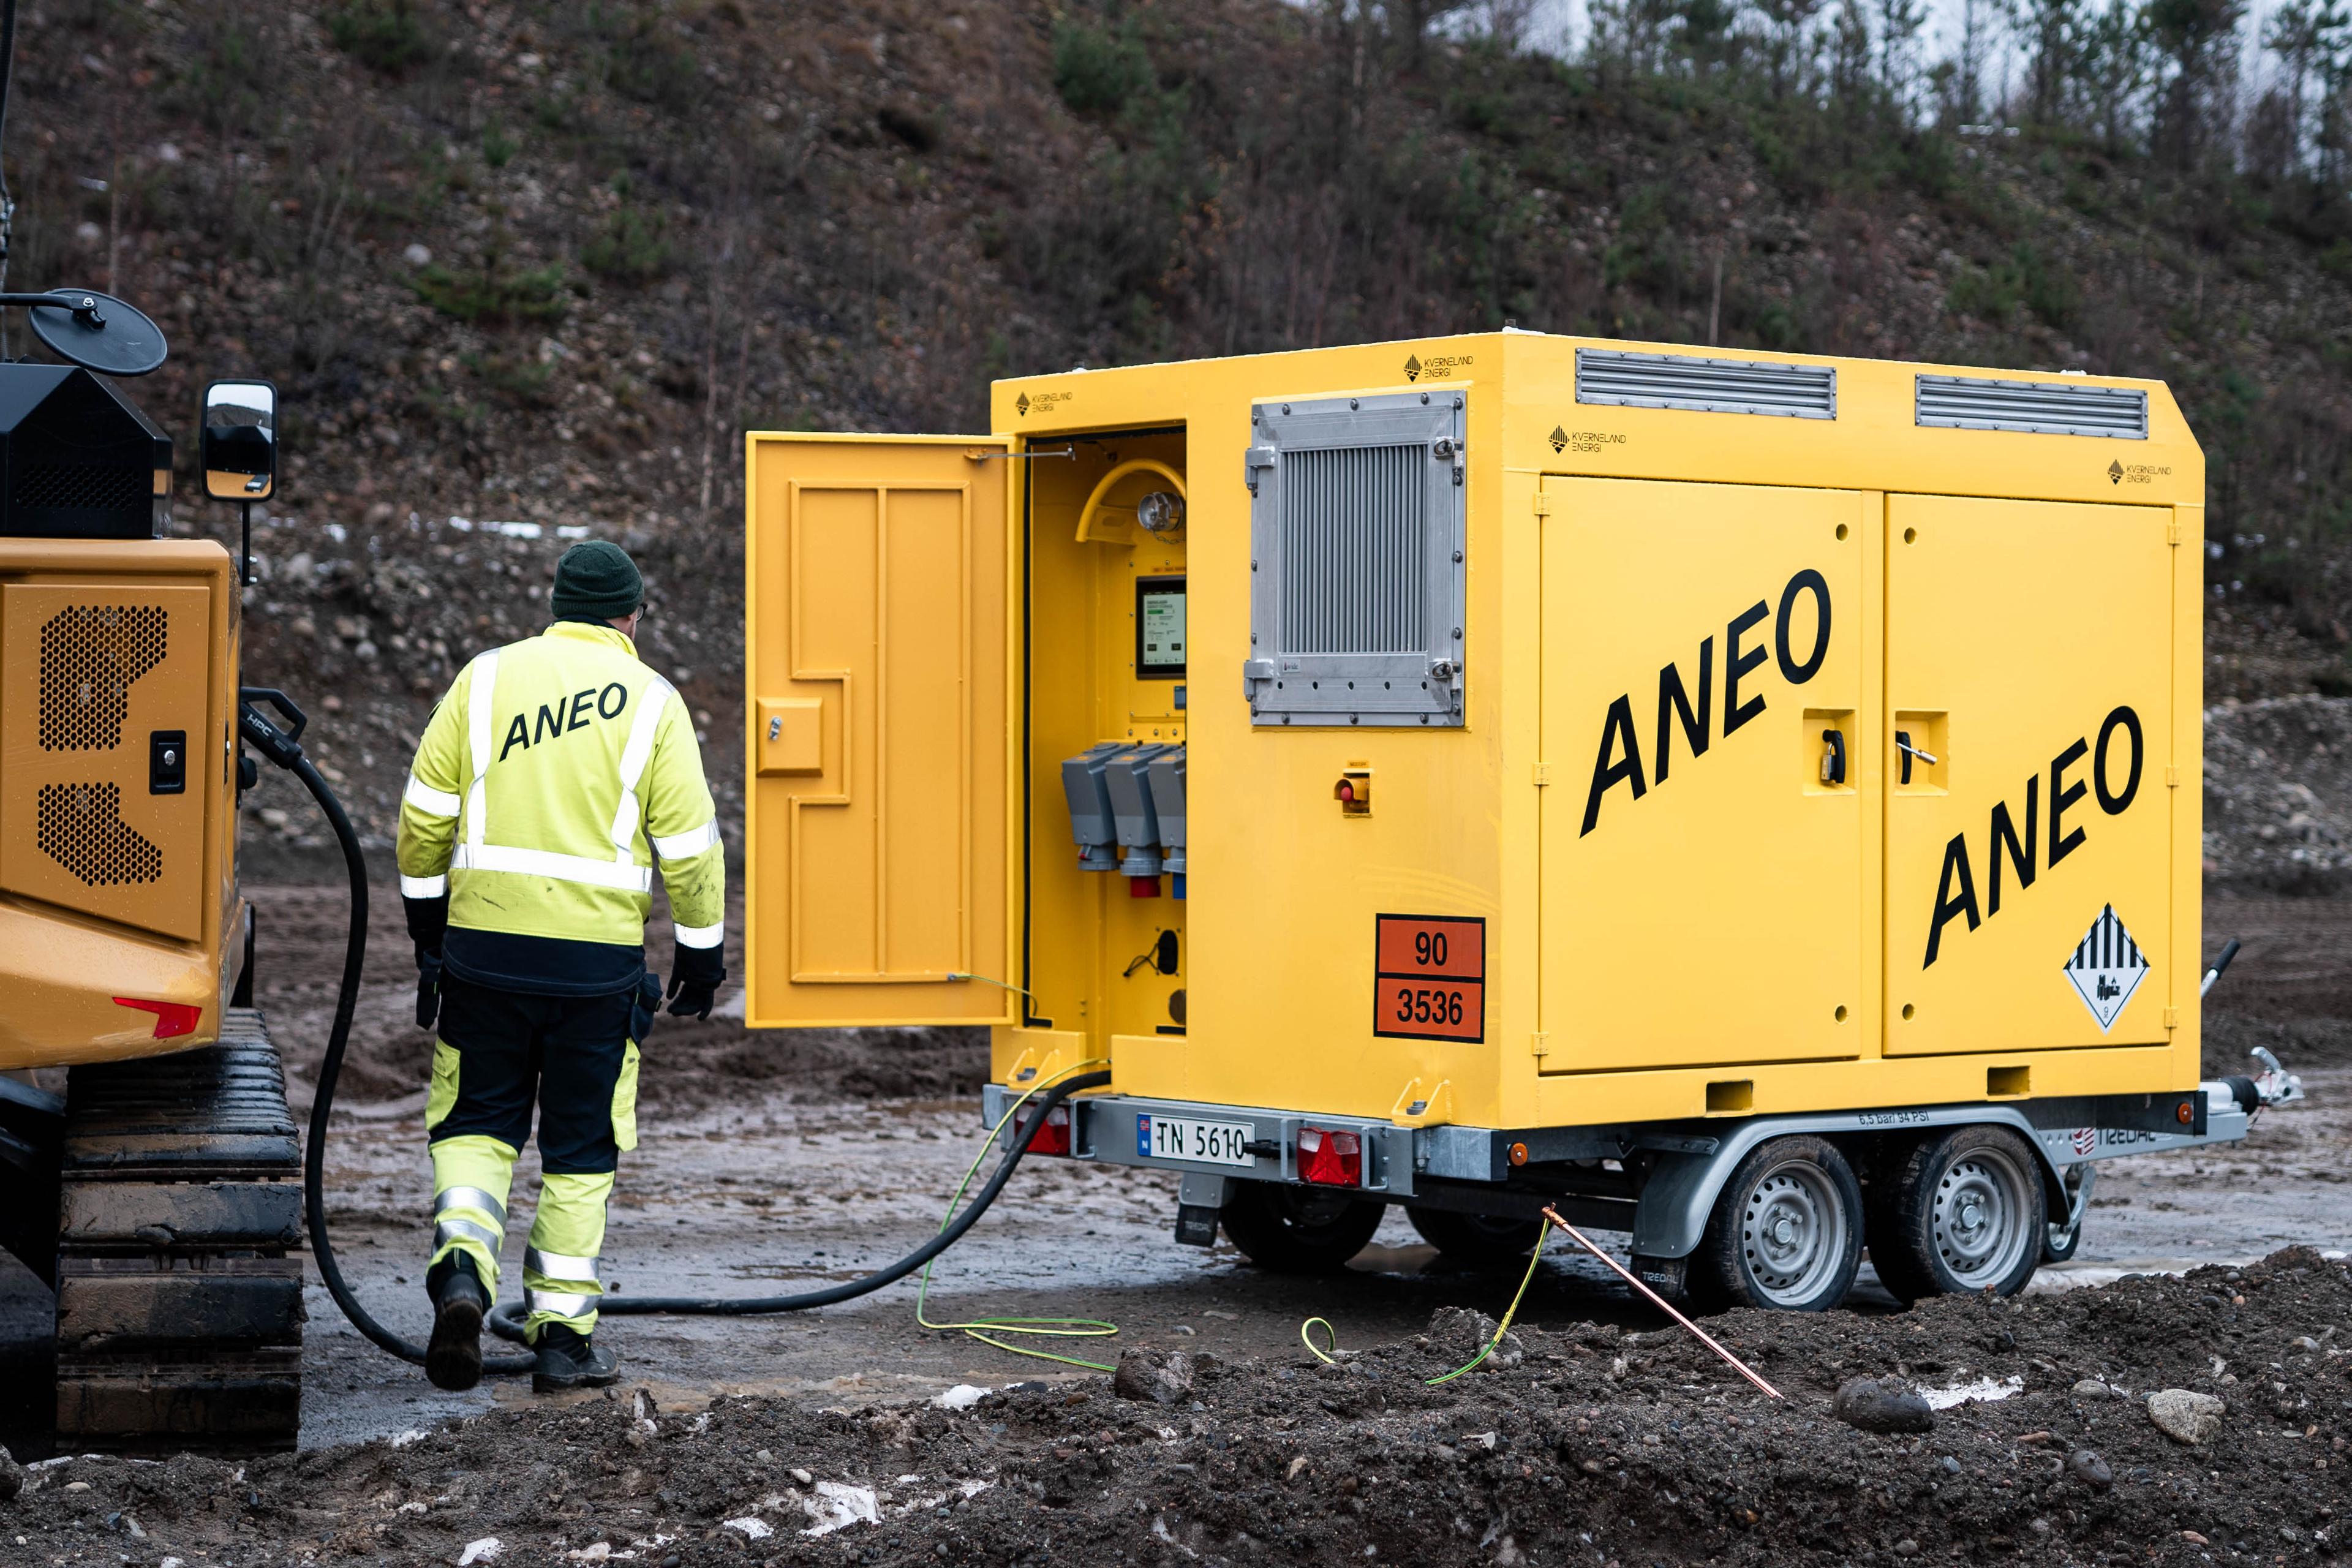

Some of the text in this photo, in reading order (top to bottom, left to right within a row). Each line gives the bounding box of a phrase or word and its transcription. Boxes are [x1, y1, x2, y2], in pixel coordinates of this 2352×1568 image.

[1424, 356, 1473, 368] KVERNELAND
[1424, 368, 1451, 378] ENERGI
[1572, 432, 1627, 443] KVERNELAND
[1572, 442, 1602, 453] ENERGI
[2127, 465, 2171, 475] KVERNELAND
[2127, 474, 2152, 483] ENERGI
[1579, 568, 1832, 839] ANEO
[247, 714, 273, 737] HPC
[498, 682, 628, 763] ANEO
[1922, 705, 2144, 971] ANEO
[1415, 931, 1448, 967] 90
[1396, 989, 1463, 1026] 3536
[2103, 1006, 2109, 1016] 9
[1858, 1114, 1874, 1126] 6,5
[1898, 1112, 1910, 1123] 94
[1912, 1110, 1929, 1122] PSI
[1157, 1122, 1245, 1159] TN 5610
[1642, 1271, 1678, 1284] TREDAL
